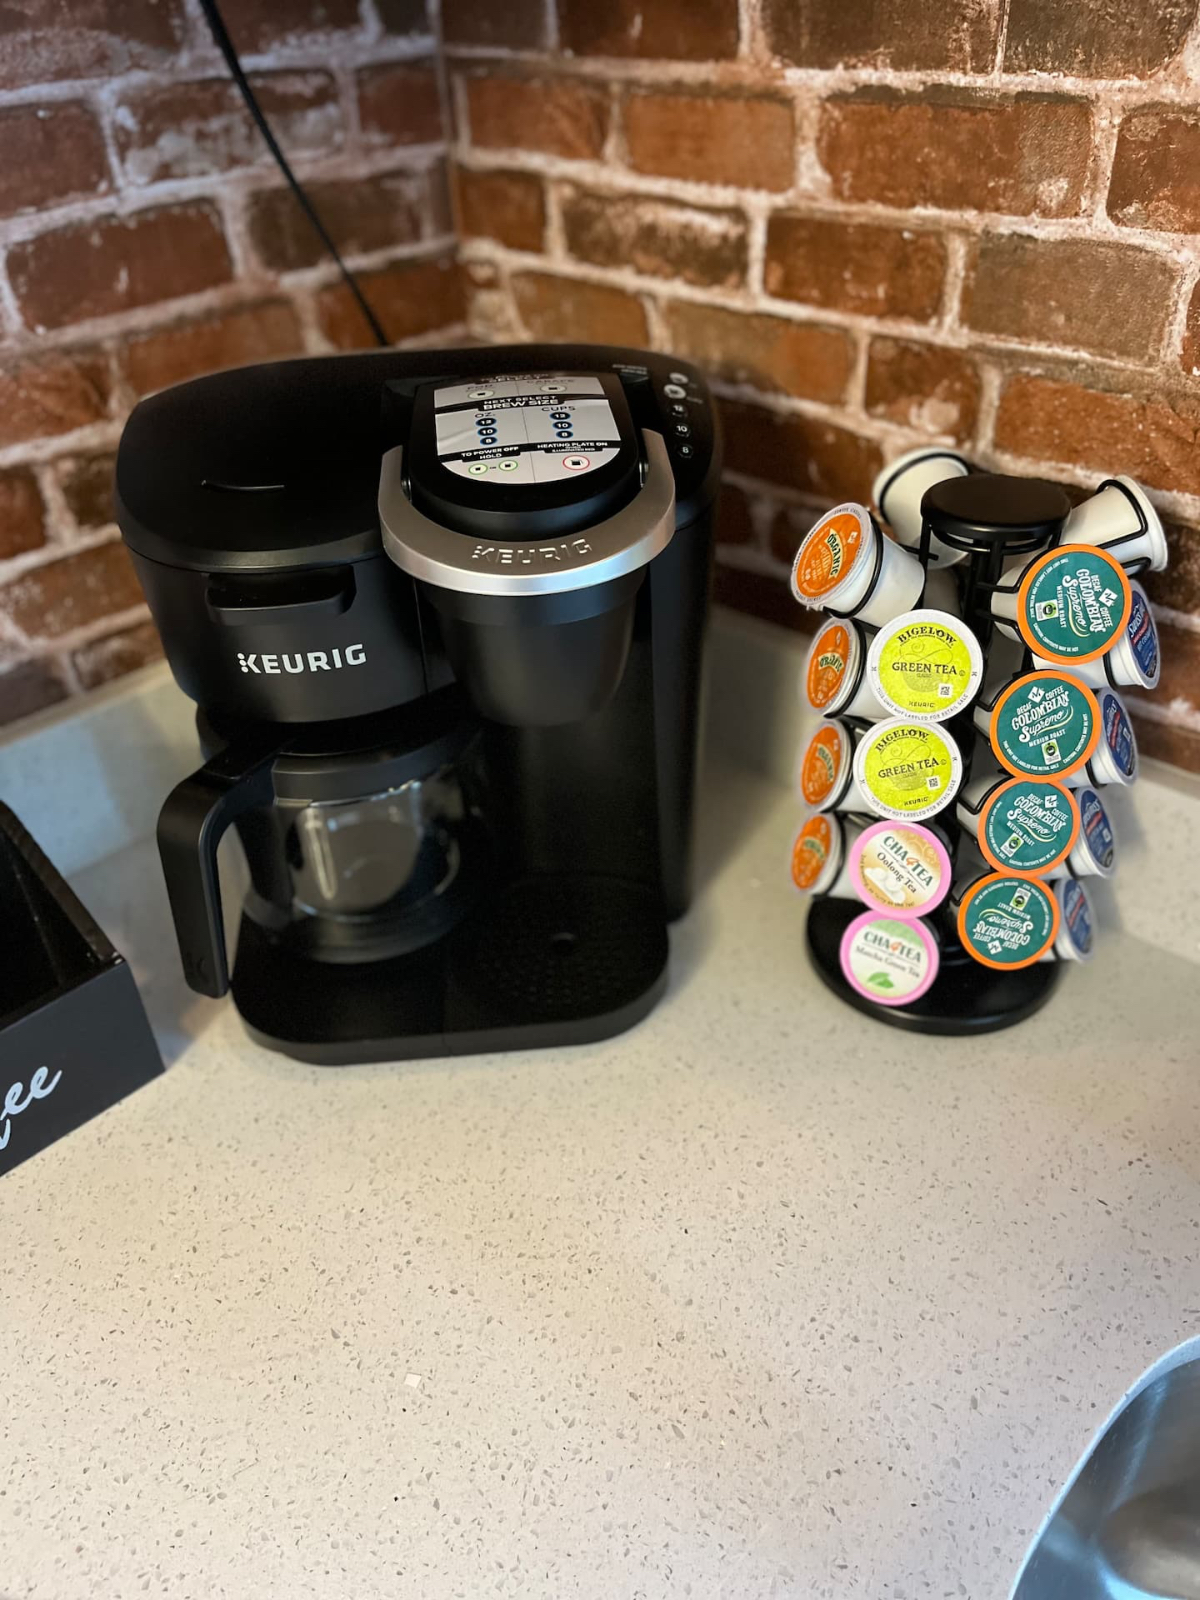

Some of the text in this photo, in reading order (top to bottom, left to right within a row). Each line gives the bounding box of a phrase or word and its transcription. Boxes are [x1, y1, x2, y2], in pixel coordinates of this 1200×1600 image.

[483, 401, 525, 410] BREW
[473, 447, 502, 455] POWER
[471, 538, 592, 563] KEURIG
[1056, 585, 1067, 628] MEDIUM ROAST
[1062, 575, 1087, 627] Supremo
[1076, 568, 1106, 633] COLOMBIAN
[1090, 575, 1113, 628] DECAF COFFEE
[896, 626, 957, 644] BIGELOW
[237, 644, 366, 674] KEURIG
[892, 662, 957, 675] GREEN TEA
[1011, 690, 1069, 730] COLOMBIAN
[1016, 685, 1064, 715] DECAF COFFEE
[875, 728, 930, 752] BIGELOW
[1019, 710, 1064, 743] Supremo
[1029, 729, 1066, 747] MEDIUM ROAST
[878, 757, 939, 778] GREEN TEA
[1014, 796, 1066, 832] COLOMBIAN
[1027, 793, 1068, 821] DECAF COFFEE
[1006, 808, 1050, 834] Supremo
[1006, 820, 1035, 847] MEDIUM ROAST
[877, 852, 904, 882] Oolong
[904, 878, 917, 894] Tea
[884, 957, 906, 972] Green
[908, 966, 920, 978] Tea
